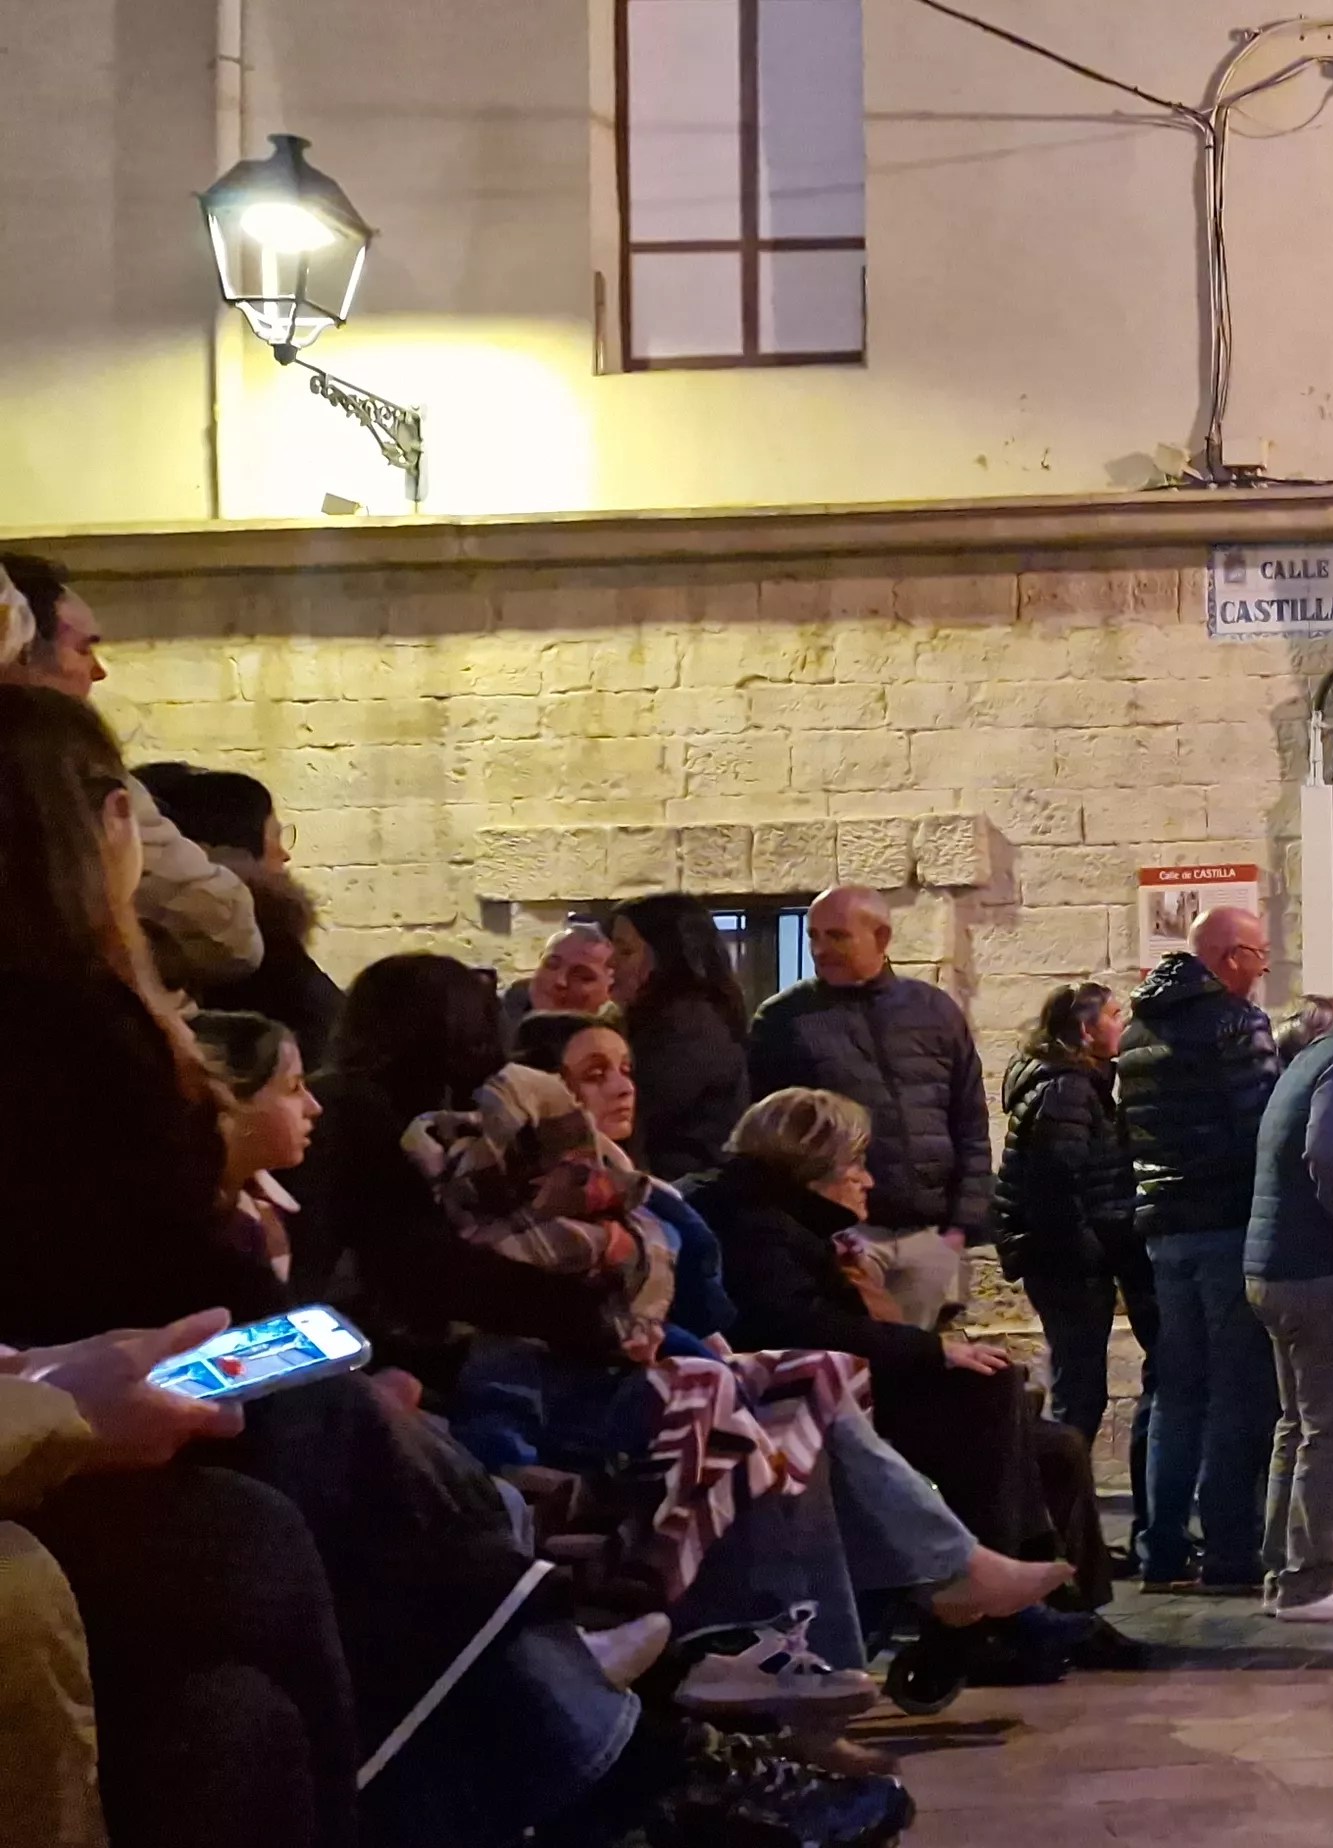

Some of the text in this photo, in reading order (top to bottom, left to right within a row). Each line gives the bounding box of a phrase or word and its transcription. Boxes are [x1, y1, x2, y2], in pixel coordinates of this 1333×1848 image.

[1260, 558, 1330, 580] CALLE
[1159, 868, 1236, 881] Calle de CASTILLA
